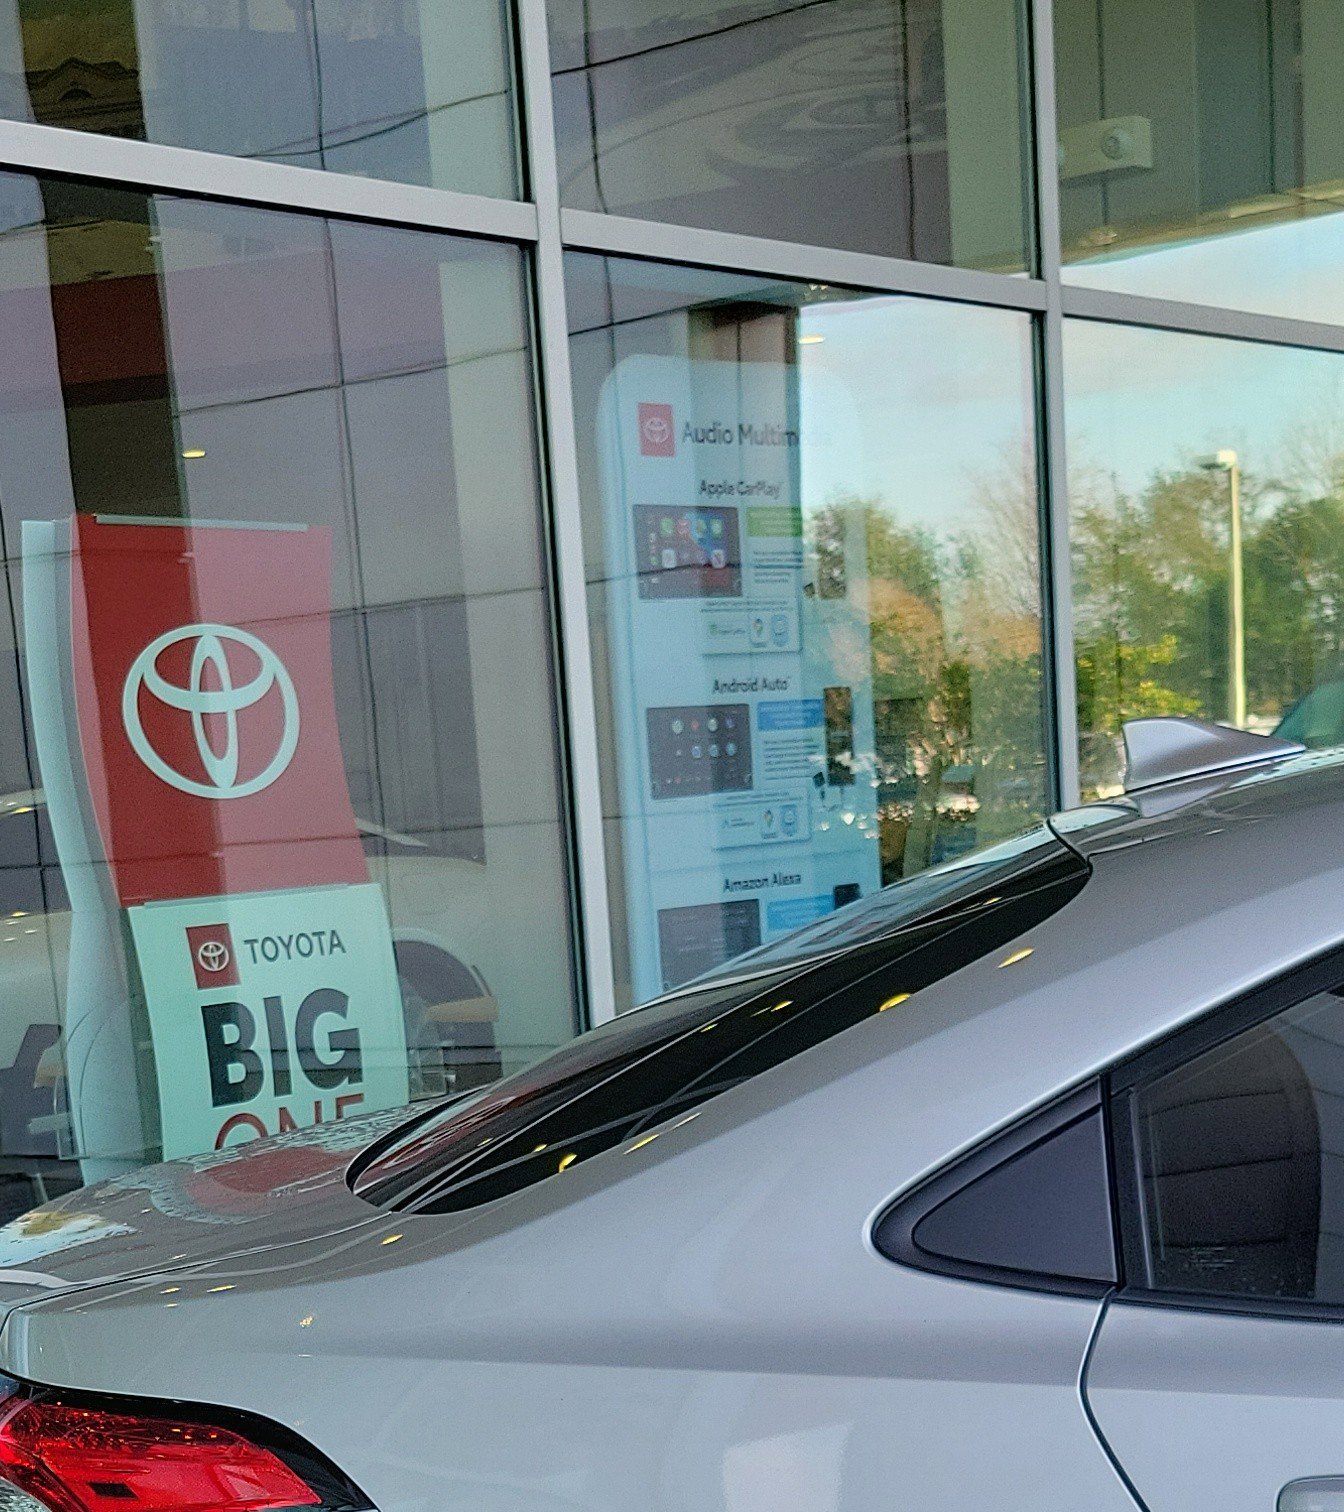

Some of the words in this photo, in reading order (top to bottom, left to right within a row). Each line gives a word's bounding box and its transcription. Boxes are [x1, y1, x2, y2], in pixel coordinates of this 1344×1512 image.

[682, 422, 734, 446] Audio
[738, 423, 800, 447] Multim
[698, 479, 735, 500] Apple
[712, 678, 757, 694] Android
[762, 677, 788, 692] Auto
[723, 877, 768, 893] Amazon
[244, 929, 347, 965] TOYOTA
[201, 987, 364, 1108] BIG
